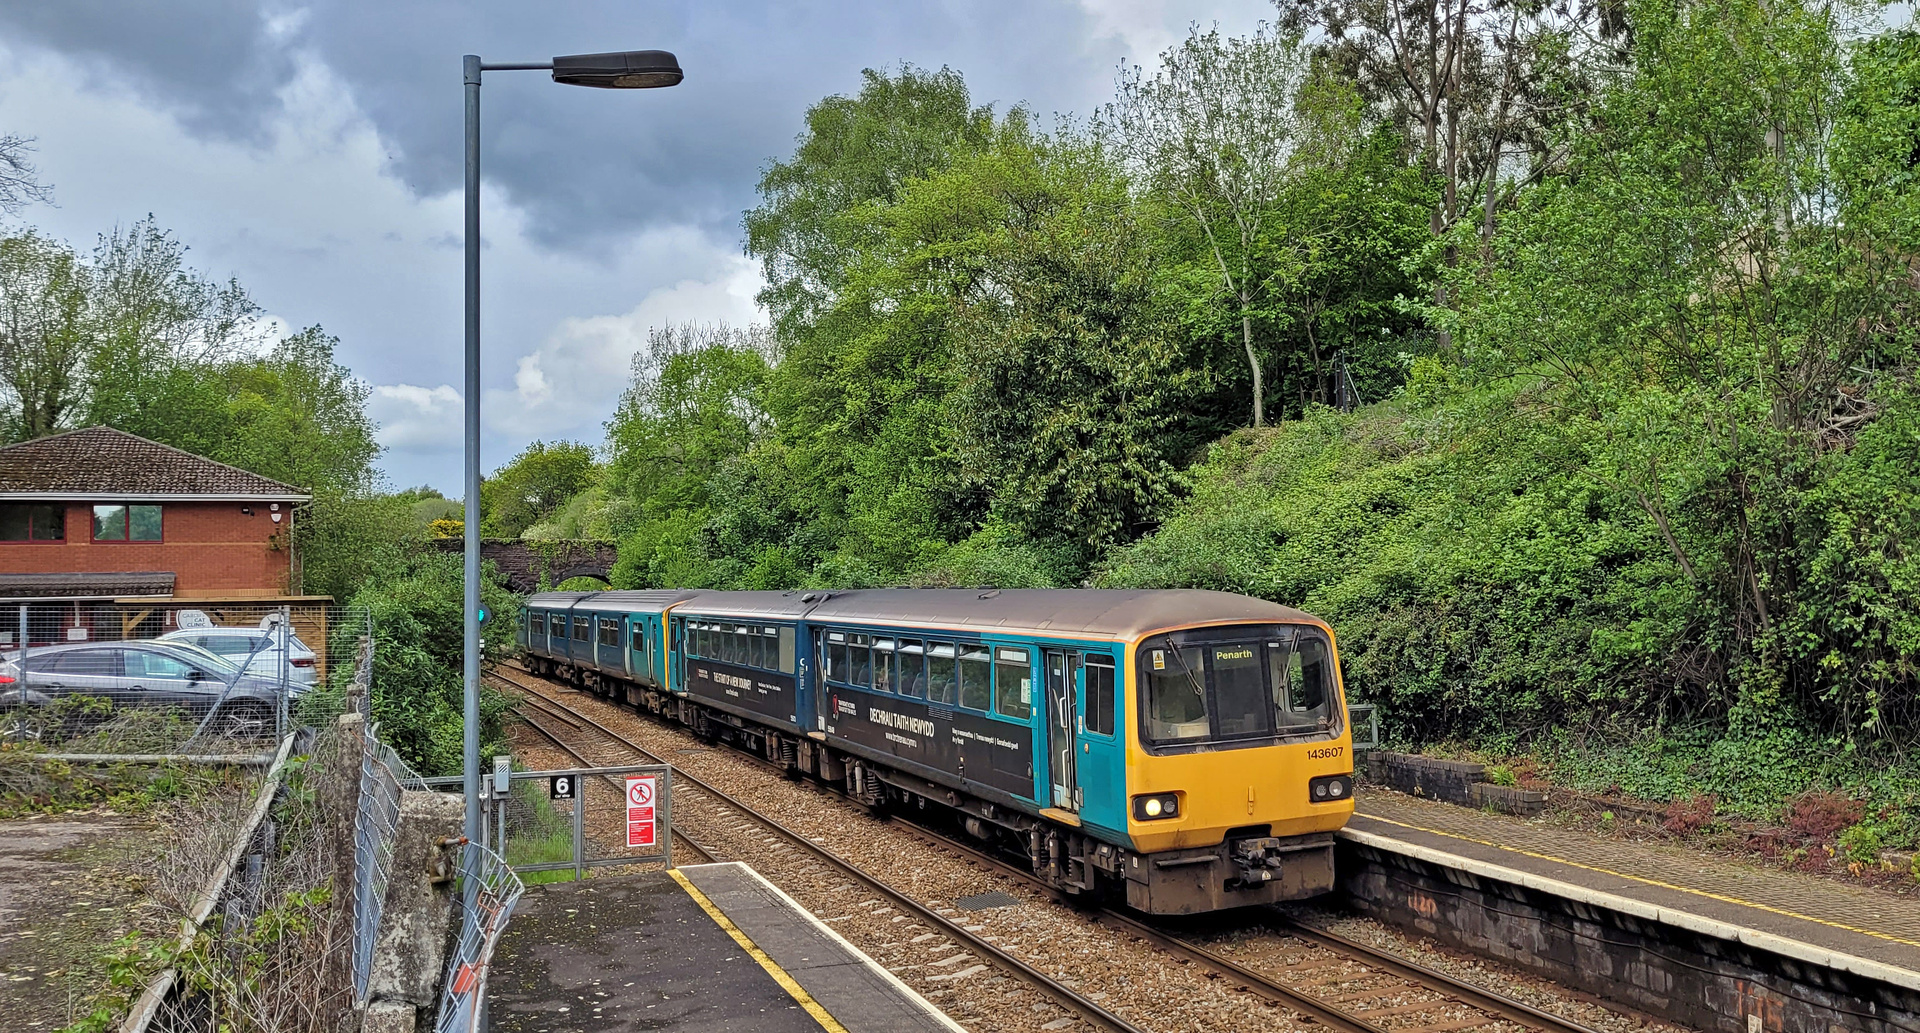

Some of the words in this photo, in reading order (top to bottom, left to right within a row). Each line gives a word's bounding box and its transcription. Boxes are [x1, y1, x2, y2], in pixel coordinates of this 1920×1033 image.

[1216, 650, 1253, 660] Penarth
[870, 707, 893, 727] DECHRAU
[893, 712, 909, 731] TAITH
[910, 717, 935, 738] NEWYDD
[1307, 746, 1344, 760] 143607
[556, 777, 569, 794] 6
